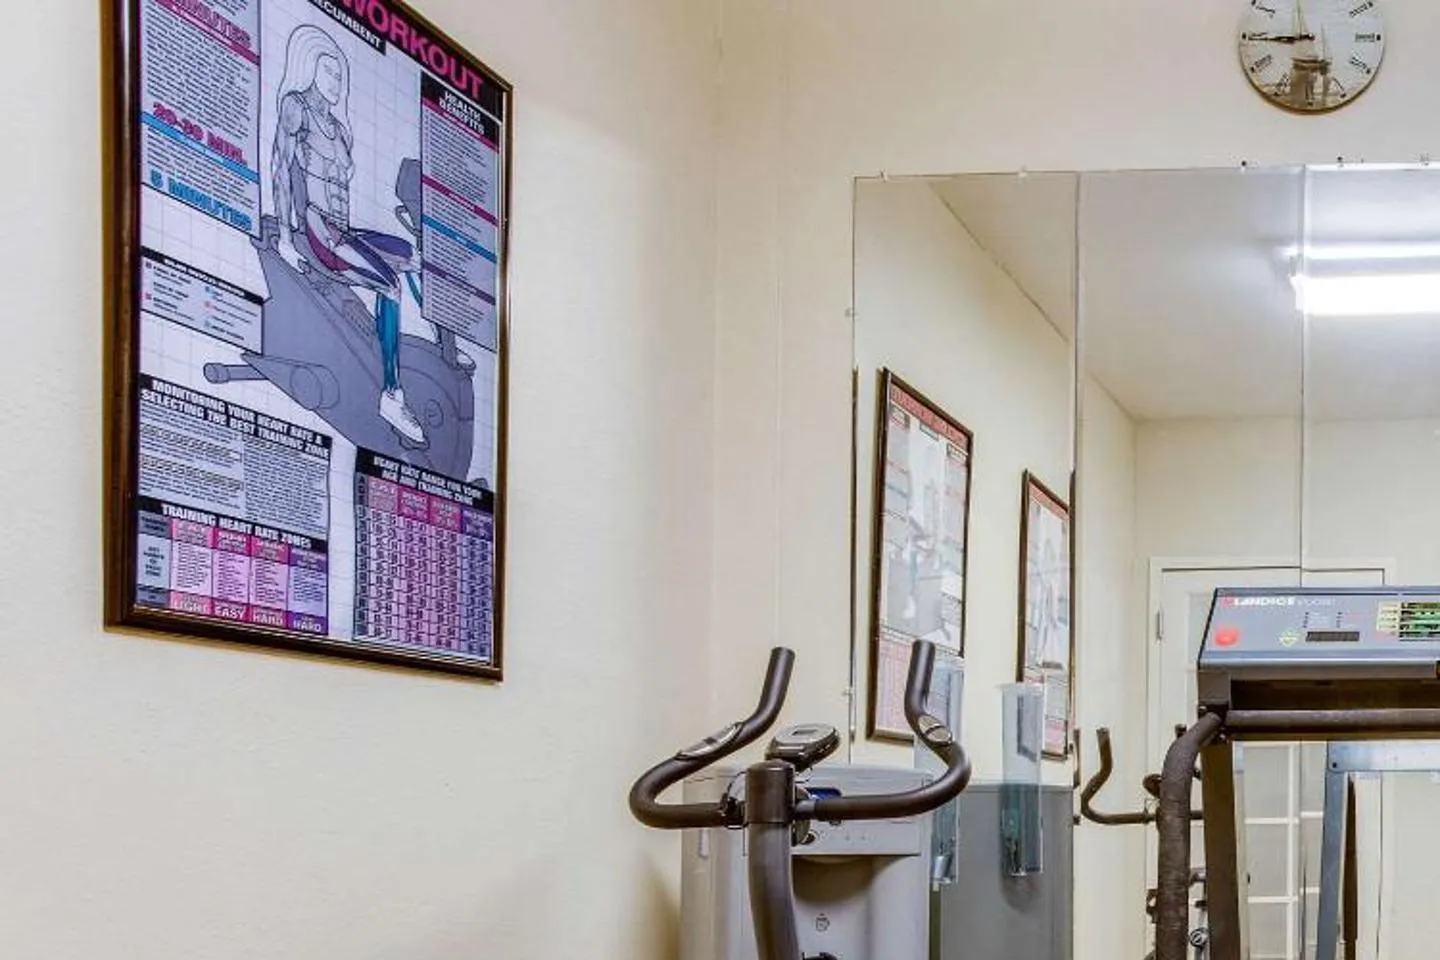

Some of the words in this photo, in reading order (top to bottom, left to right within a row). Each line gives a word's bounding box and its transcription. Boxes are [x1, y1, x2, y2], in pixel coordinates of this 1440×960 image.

[161, 503, 216, 527] TRAINING
[219, 516, 252, 534] HEART
[214, 605, 246, 620] EASY
[253, 613, 283, 626] HARD
